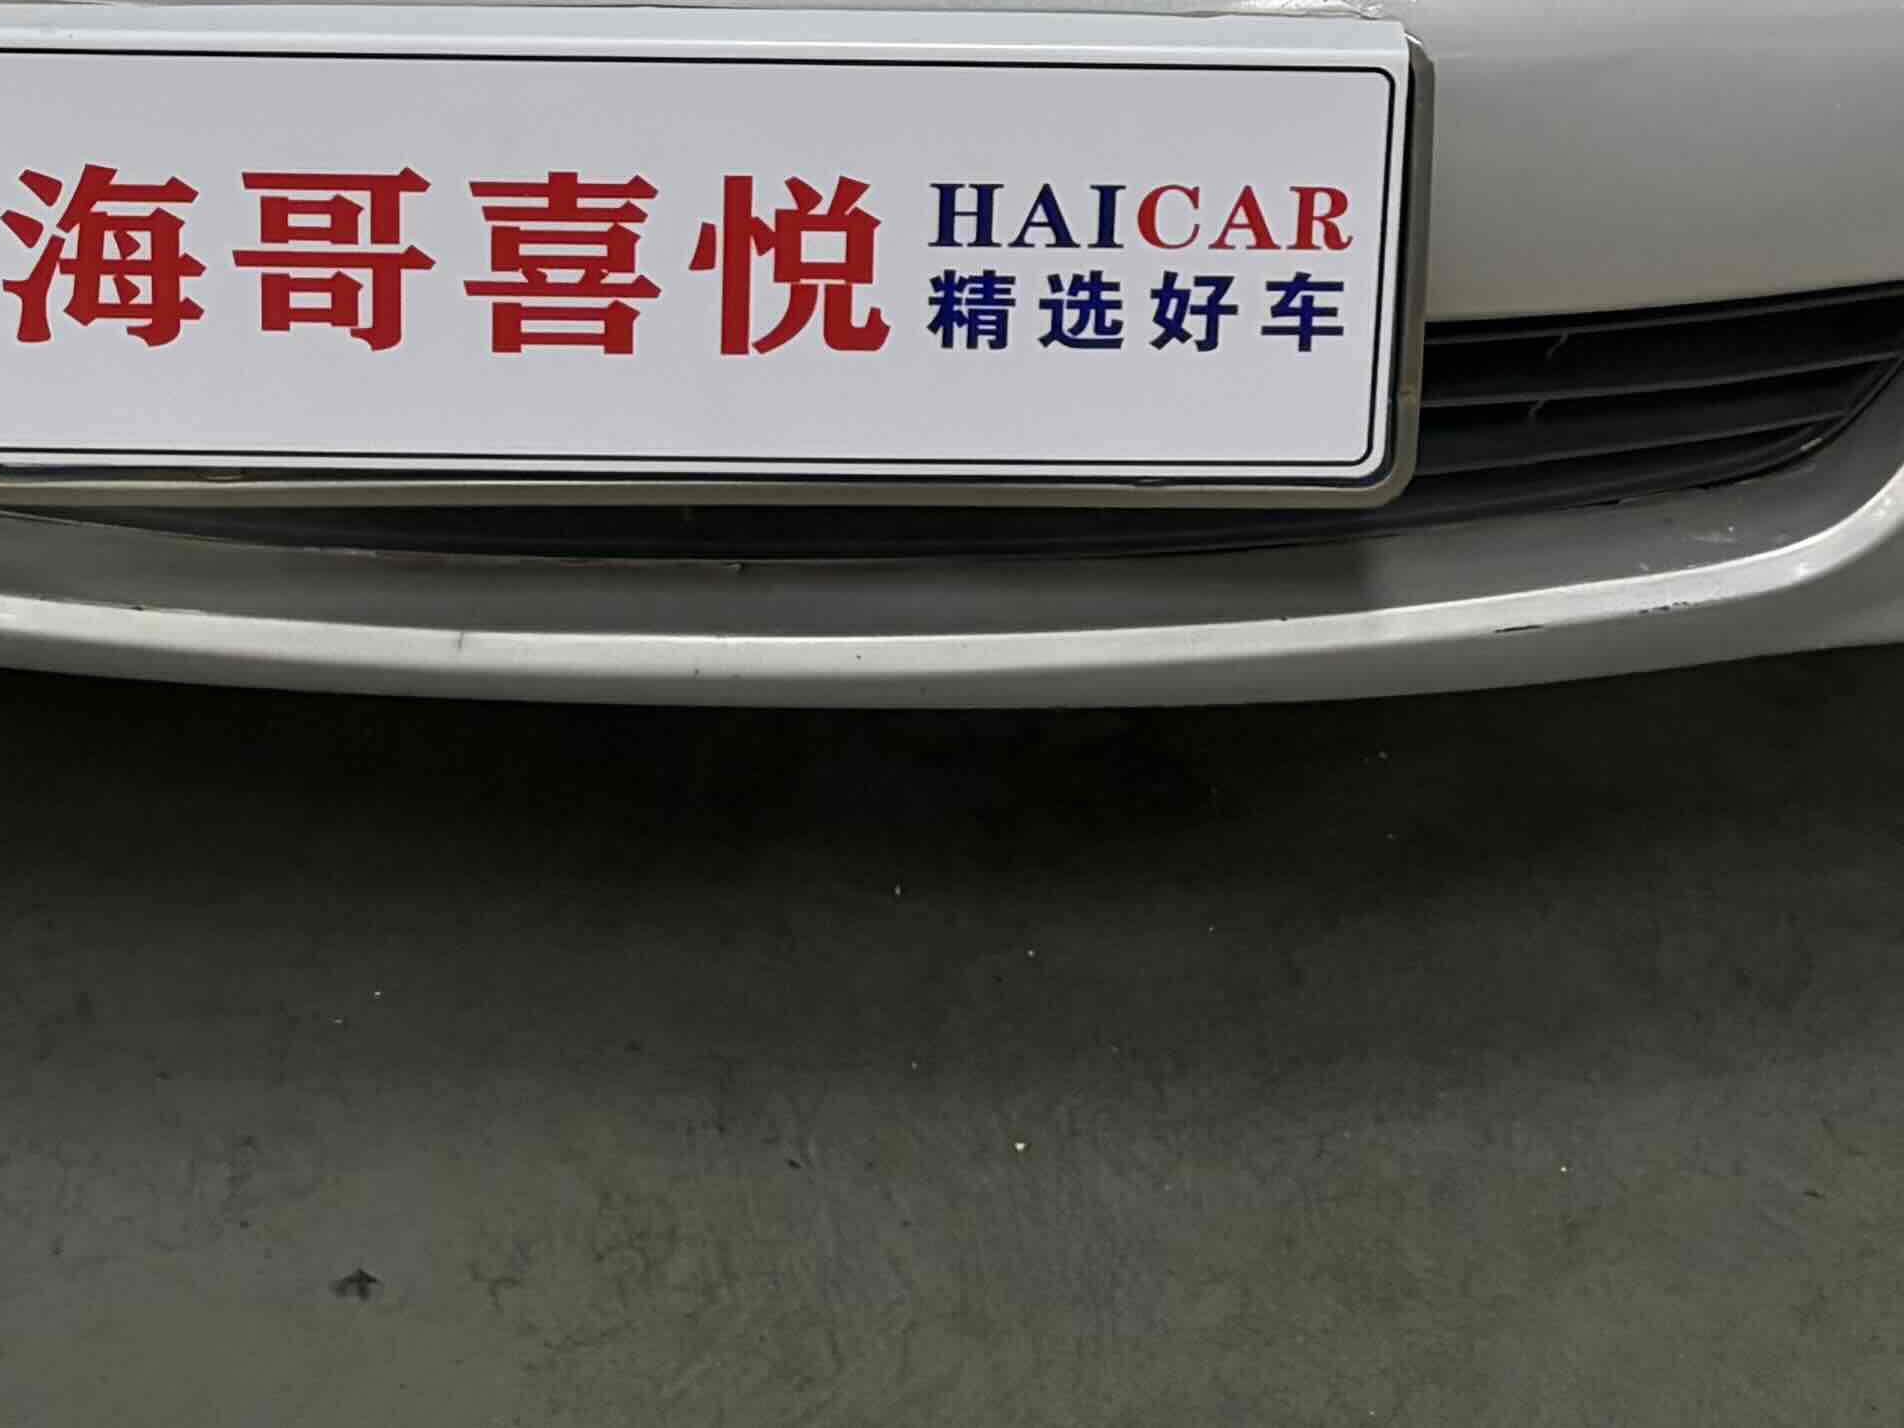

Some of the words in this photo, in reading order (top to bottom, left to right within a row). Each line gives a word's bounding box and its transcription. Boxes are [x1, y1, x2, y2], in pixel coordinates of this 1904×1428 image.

[927, 182, 1353, 251] HAICAR
[0, 164, 891, 356] 海哥喜悦
[926, 268, 1345, 353] 精选好车
